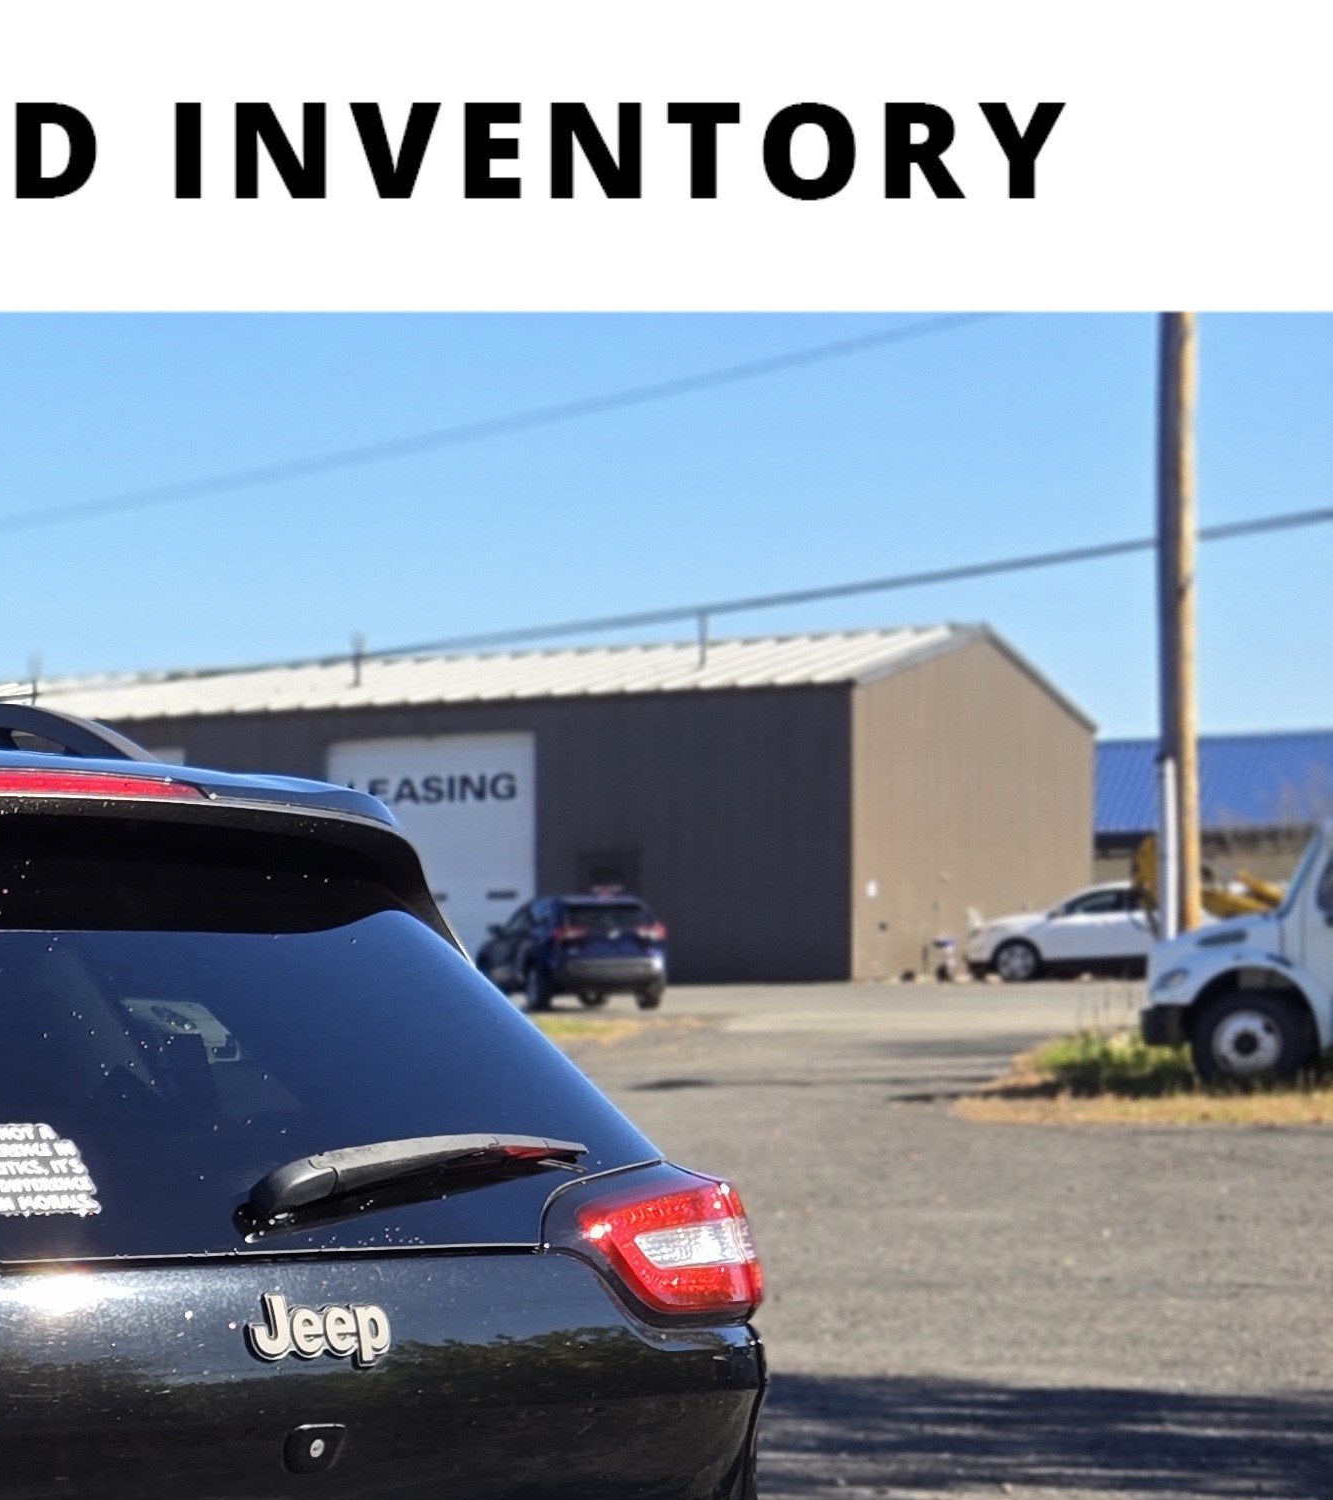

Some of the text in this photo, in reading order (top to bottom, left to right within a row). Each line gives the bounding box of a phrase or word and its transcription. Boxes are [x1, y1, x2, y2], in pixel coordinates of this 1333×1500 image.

[39, 1126, 55, 1141] A
[54, 1142, 77, 1157] IN
[249, 1292, 391, 1367] Jeep
